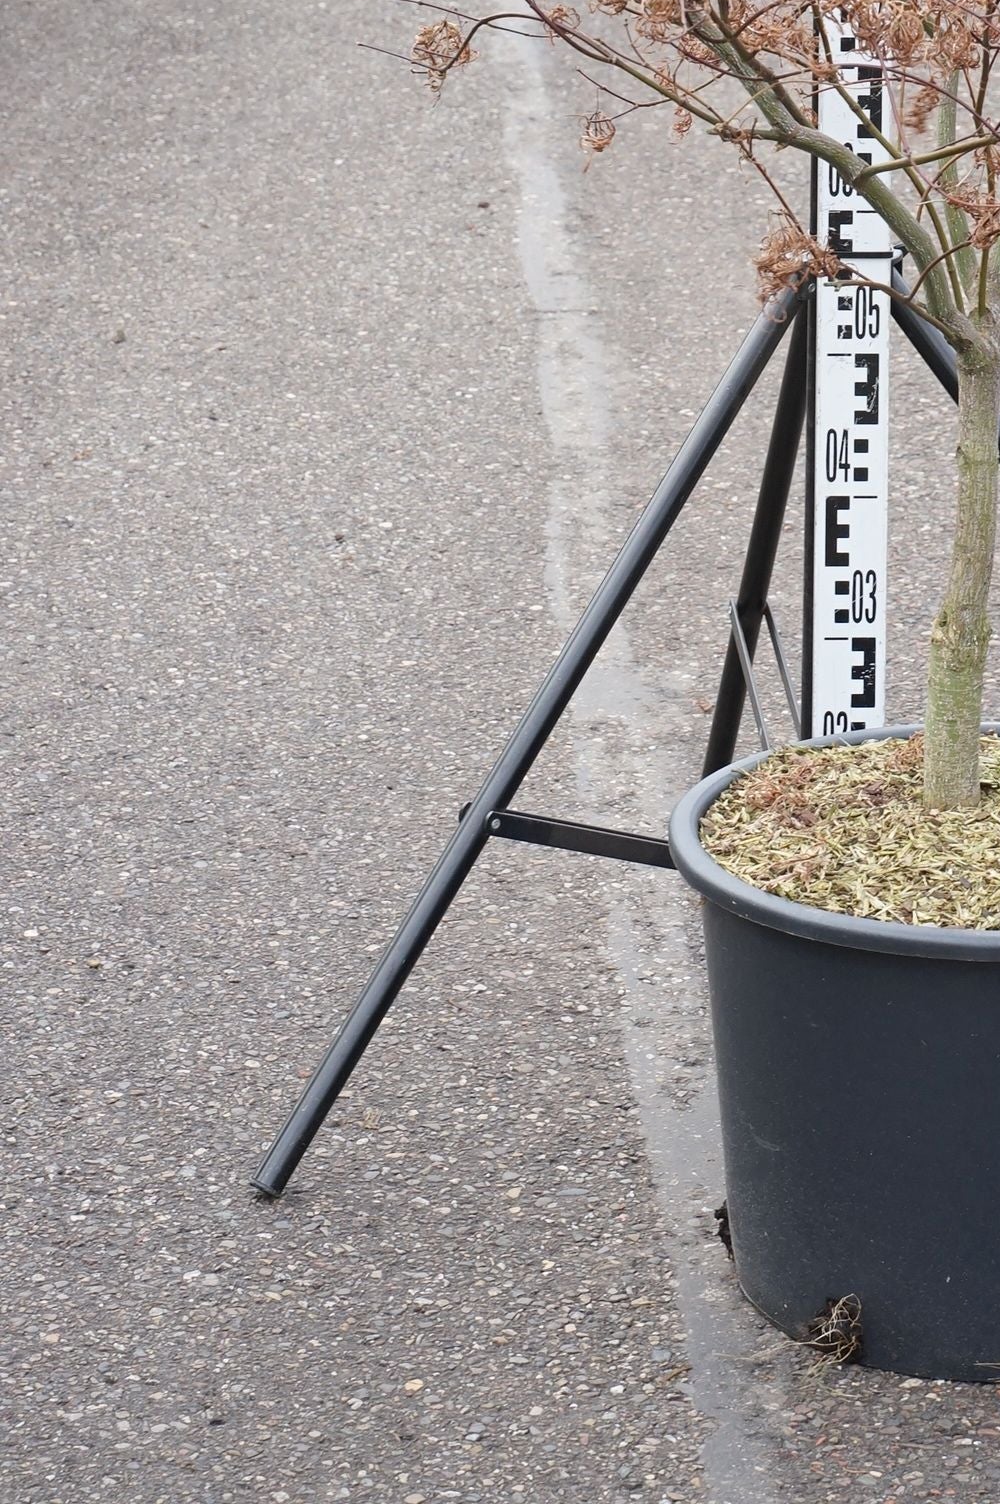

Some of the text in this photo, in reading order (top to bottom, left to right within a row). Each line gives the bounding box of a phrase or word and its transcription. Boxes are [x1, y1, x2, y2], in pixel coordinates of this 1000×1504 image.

[855, 286, 880, 339] 05
[826, 428, 850, 483] 04
[852, 569, 876, 624] 03
